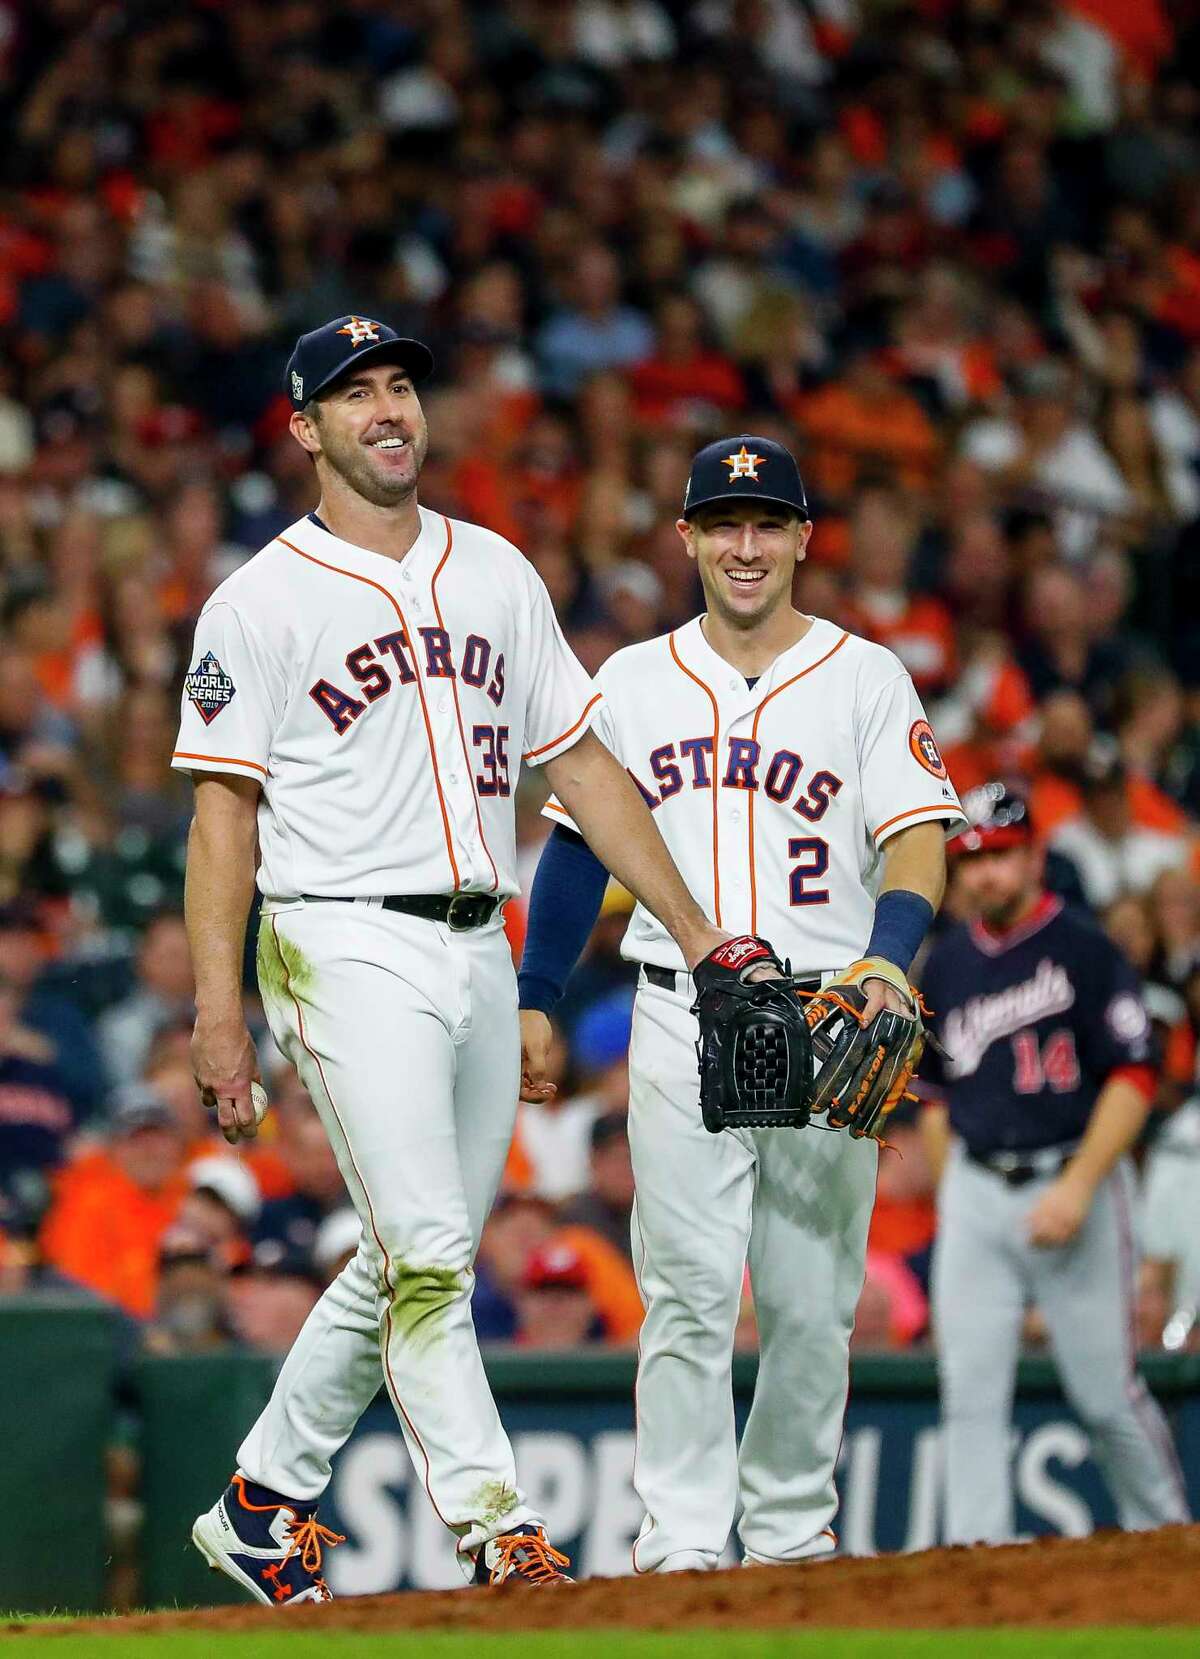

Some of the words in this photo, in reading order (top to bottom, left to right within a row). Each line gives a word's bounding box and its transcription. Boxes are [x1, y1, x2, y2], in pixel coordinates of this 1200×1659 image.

[343, 321, 379, 342] H
[729, 453, 758, 478] H
[186, 674, 232, 690] WORLD
[308, 626, 504, 736] ASTROS
[190, 687, 230, 702] SERIES
[472, 725, 511, 797] 35
[788, 837, 830, 907] 2
